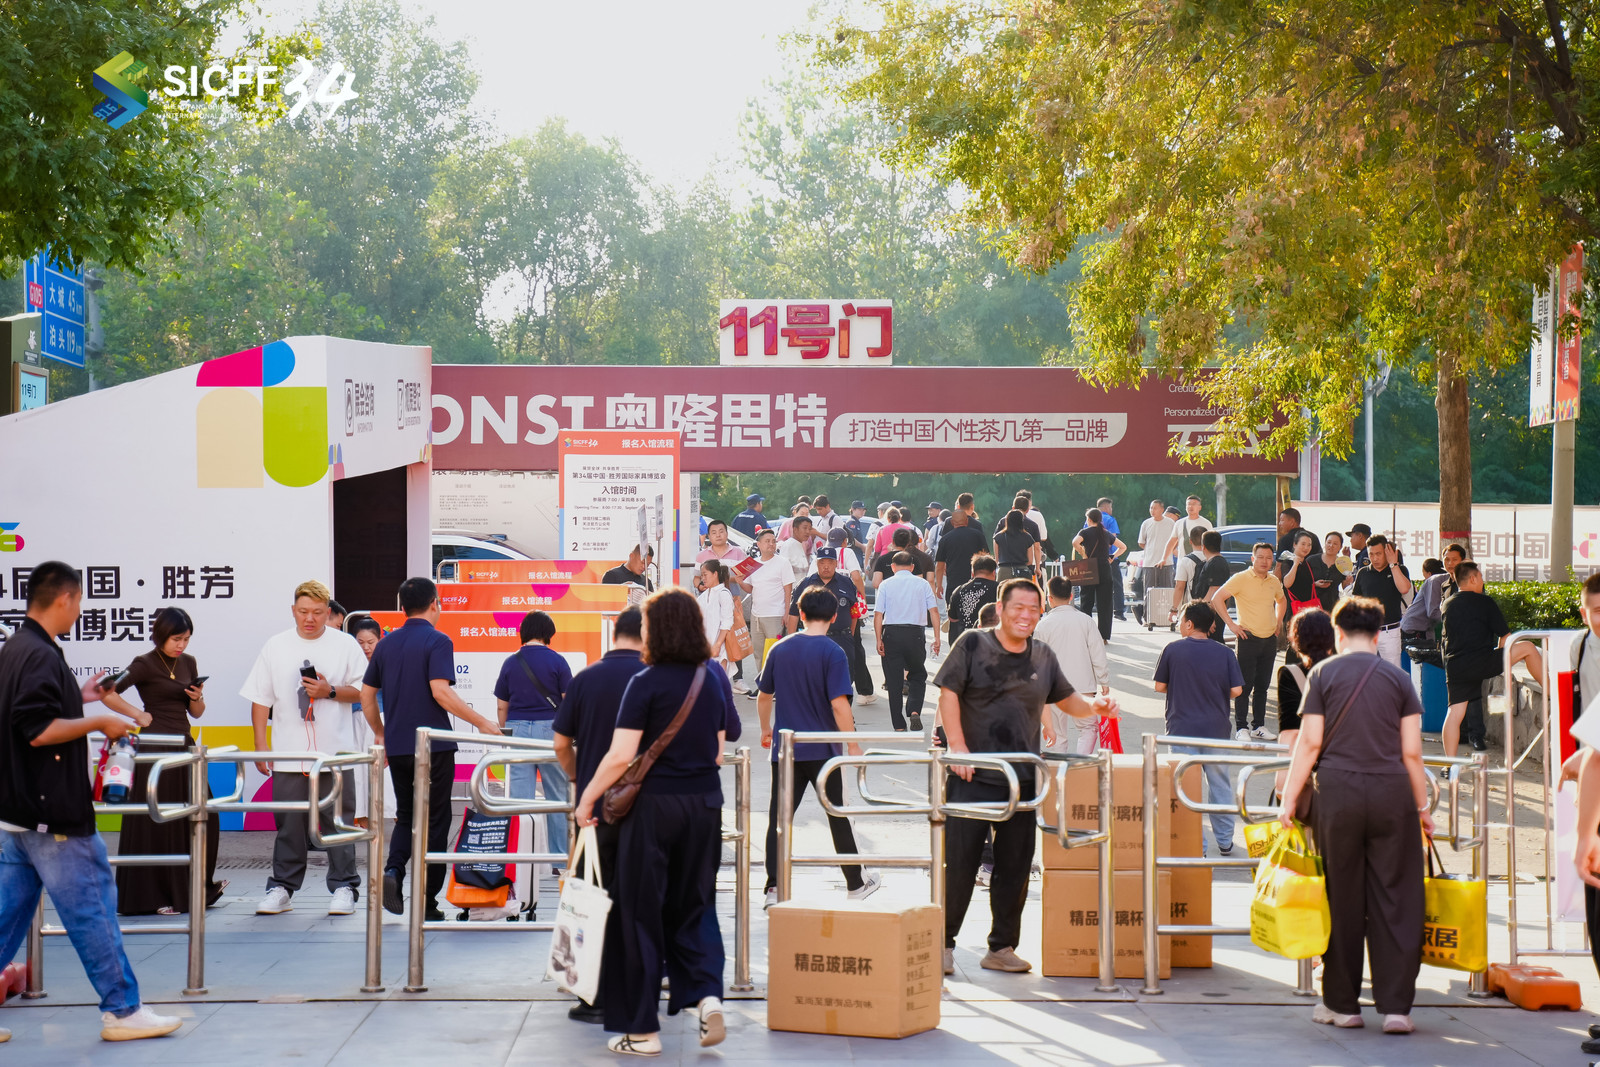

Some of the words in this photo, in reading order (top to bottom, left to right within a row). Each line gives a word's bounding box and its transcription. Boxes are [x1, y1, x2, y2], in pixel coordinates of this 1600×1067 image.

[49, 282, 66, 309] 大城
[49, 324, 66, 350] 泊头
[720, 302, 893, 359] 11号门
[21, 383, 37, 398] 11号门
[1164, 407, 1216, 417] Personalized
[606, 393, 828, 448] 奥隆思特
[848, 418, 1110, 443] 打造中国个性茶几第一品牌
[621, 439, 675, 448] 报名入馆流程
[601, 486, 637, 495] 入馆时间
[572, 516, 578, 525] 1
[571, 541, 579, 551] 2
[528, 571, 573, 580] 报名入馆流程
[502, 596, 553, 606] 报名入馆流程
[460, 626, 517, 637] 报名入馆流程
[456, 665, 469, 674] 02
[1071, 804, 1144, 822] 精品璃杯
[1069, 910, 1144, 927] 精品璃杯
[794, 952, 873, 976] 精品玻璃杯
